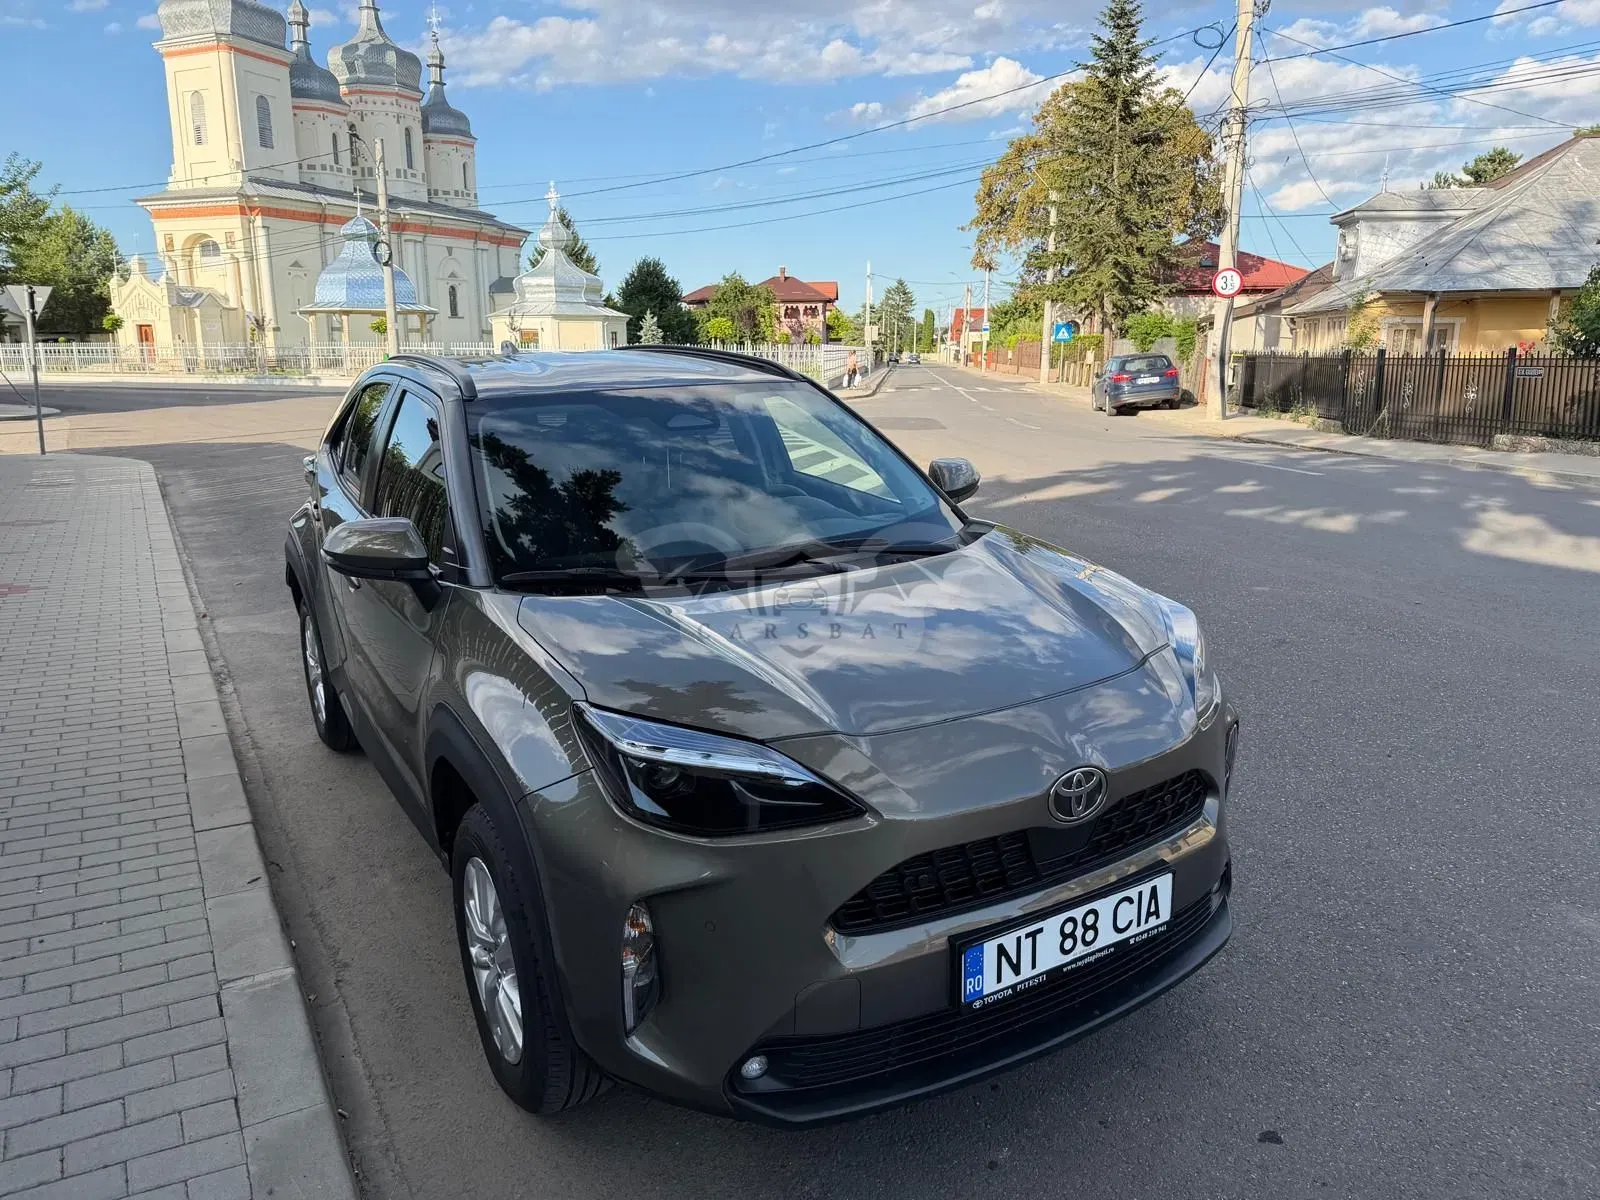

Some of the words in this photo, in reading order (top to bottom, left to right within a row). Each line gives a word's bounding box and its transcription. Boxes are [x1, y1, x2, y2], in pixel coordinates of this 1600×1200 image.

[996, 927, 1044, 984] NT
[1059, 908, 1099, 955] 88
[1112, 884, 1161, 934] CIA
[966, 974, 983, 995] RO
[983, 988, 1013, 1004] TOYOTA
